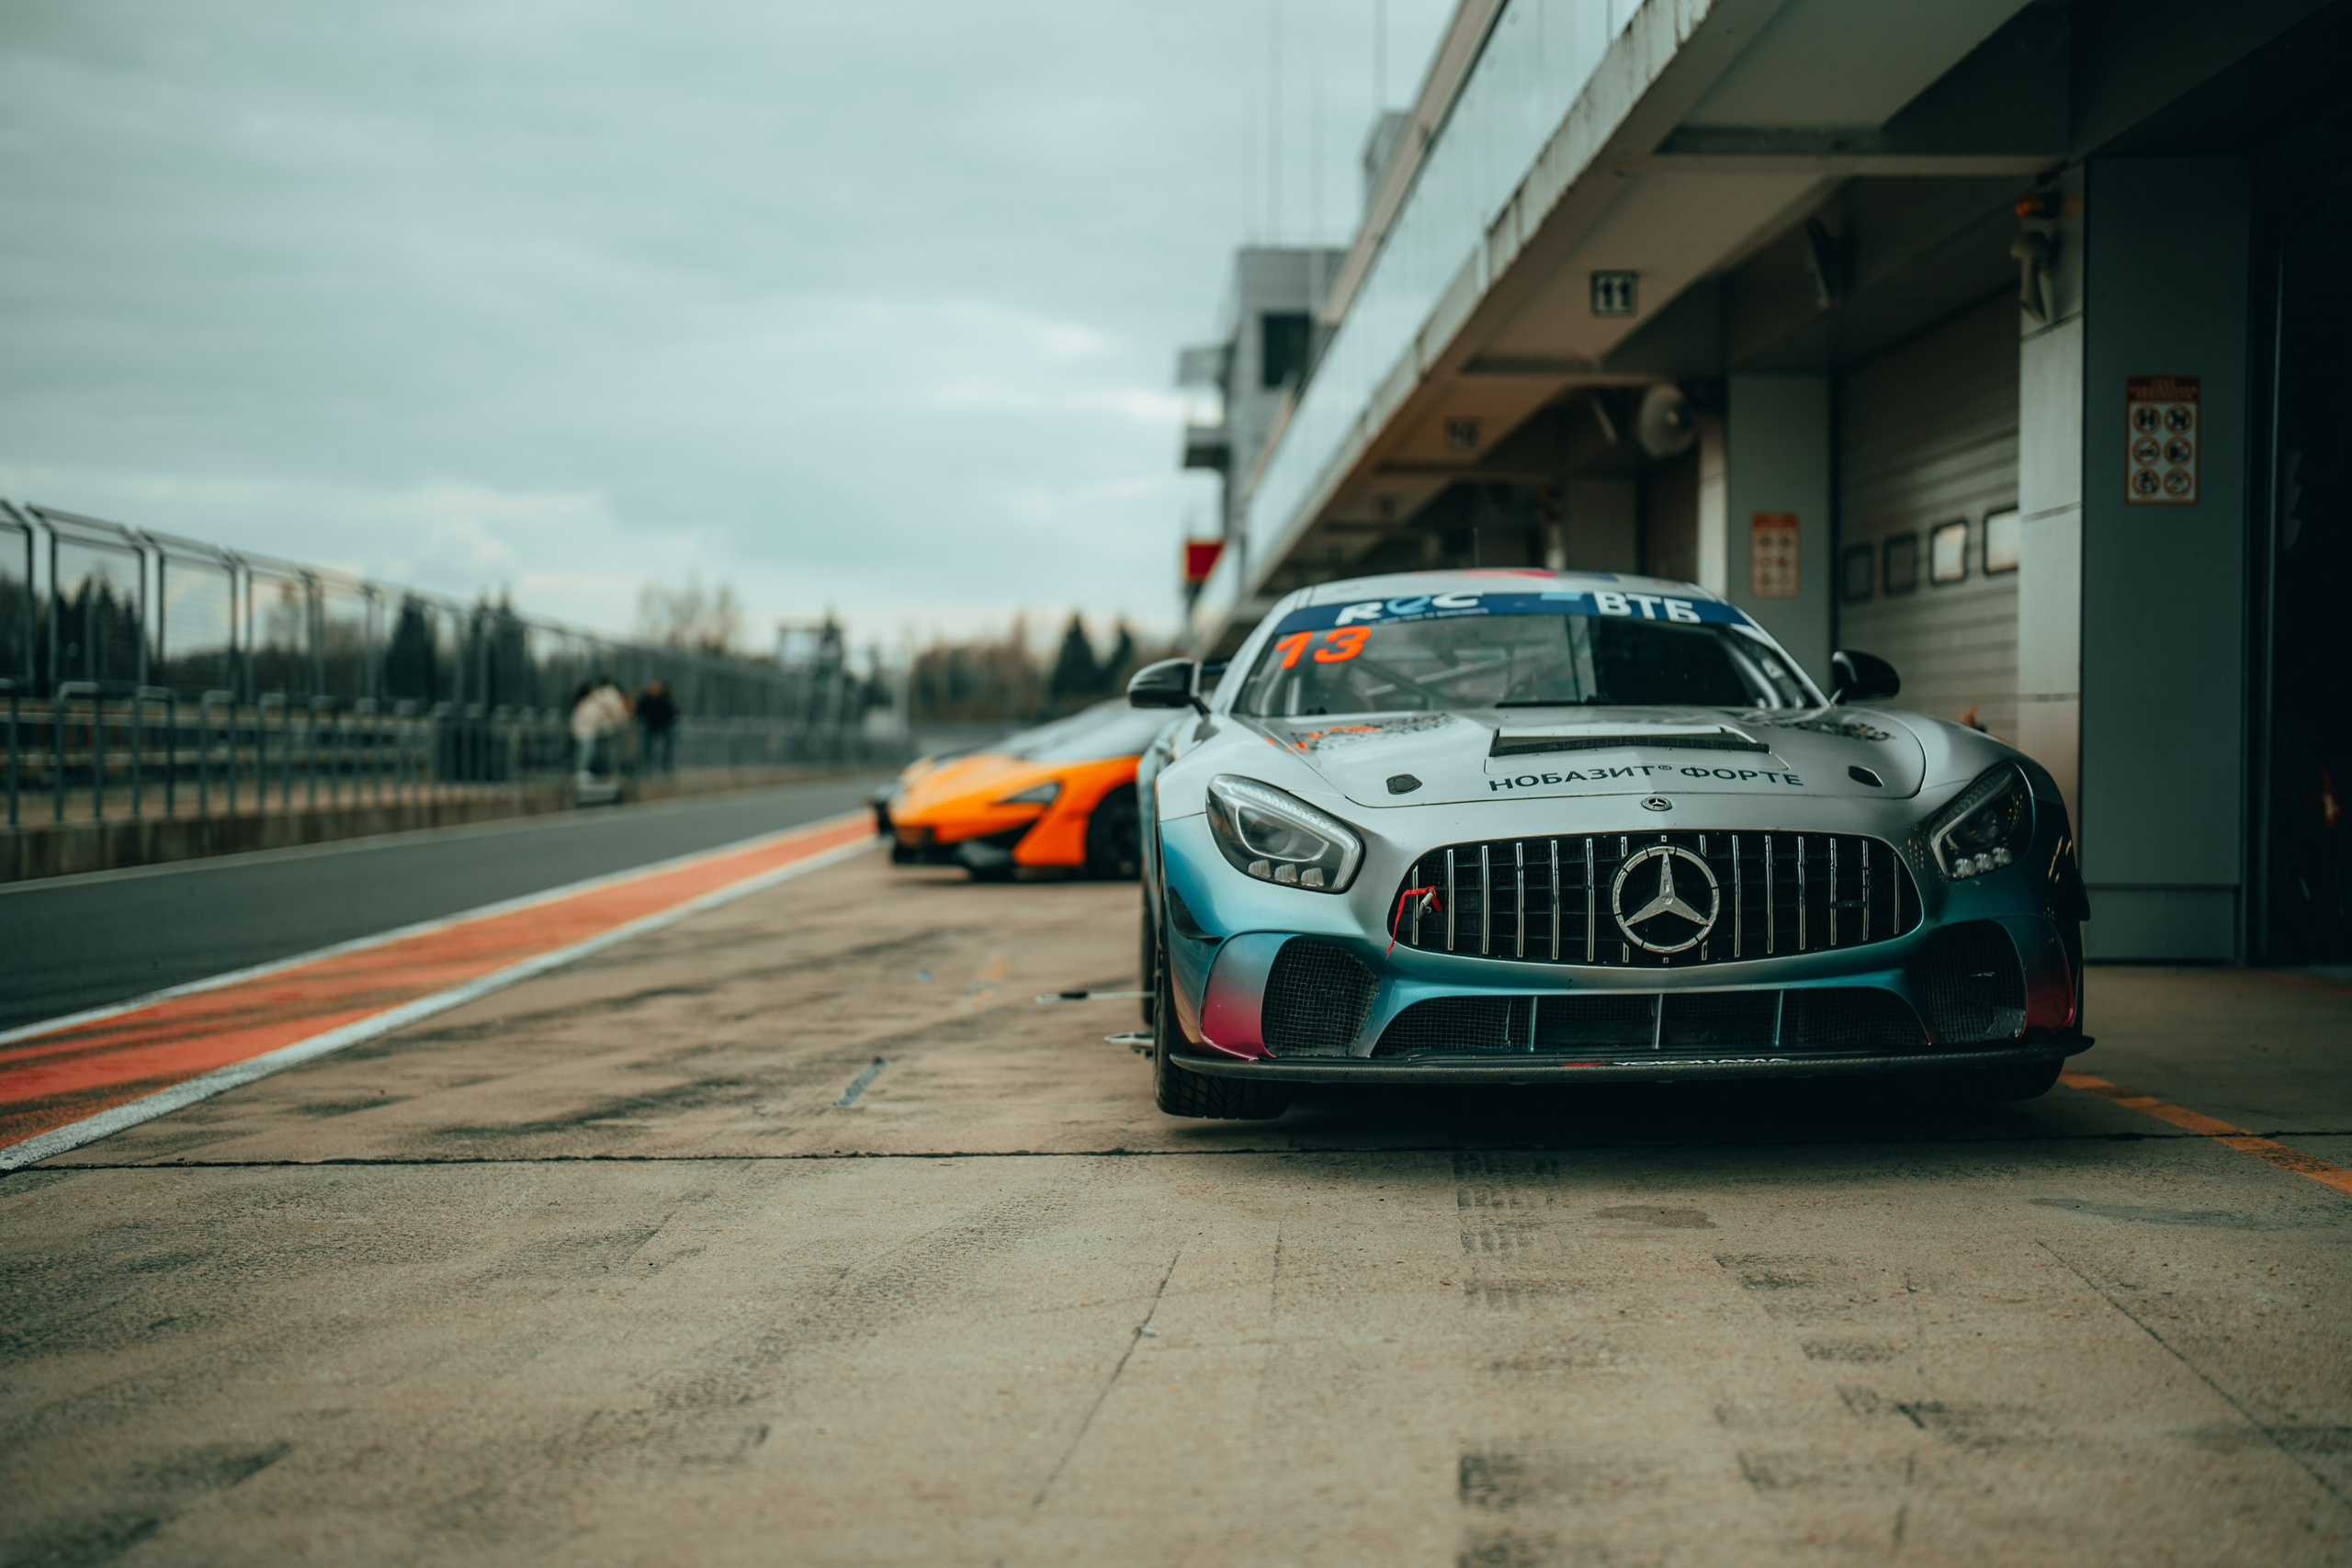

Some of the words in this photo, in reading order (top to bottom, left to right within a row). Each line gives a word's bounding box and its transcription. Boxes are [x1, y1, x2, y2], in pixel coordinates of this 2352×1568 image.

[1593, 591, 1702, 624] ВТБ
[1275, 626, 1372, 669] 13
[1680, 766, 1804, 787] ФОРТЕ
